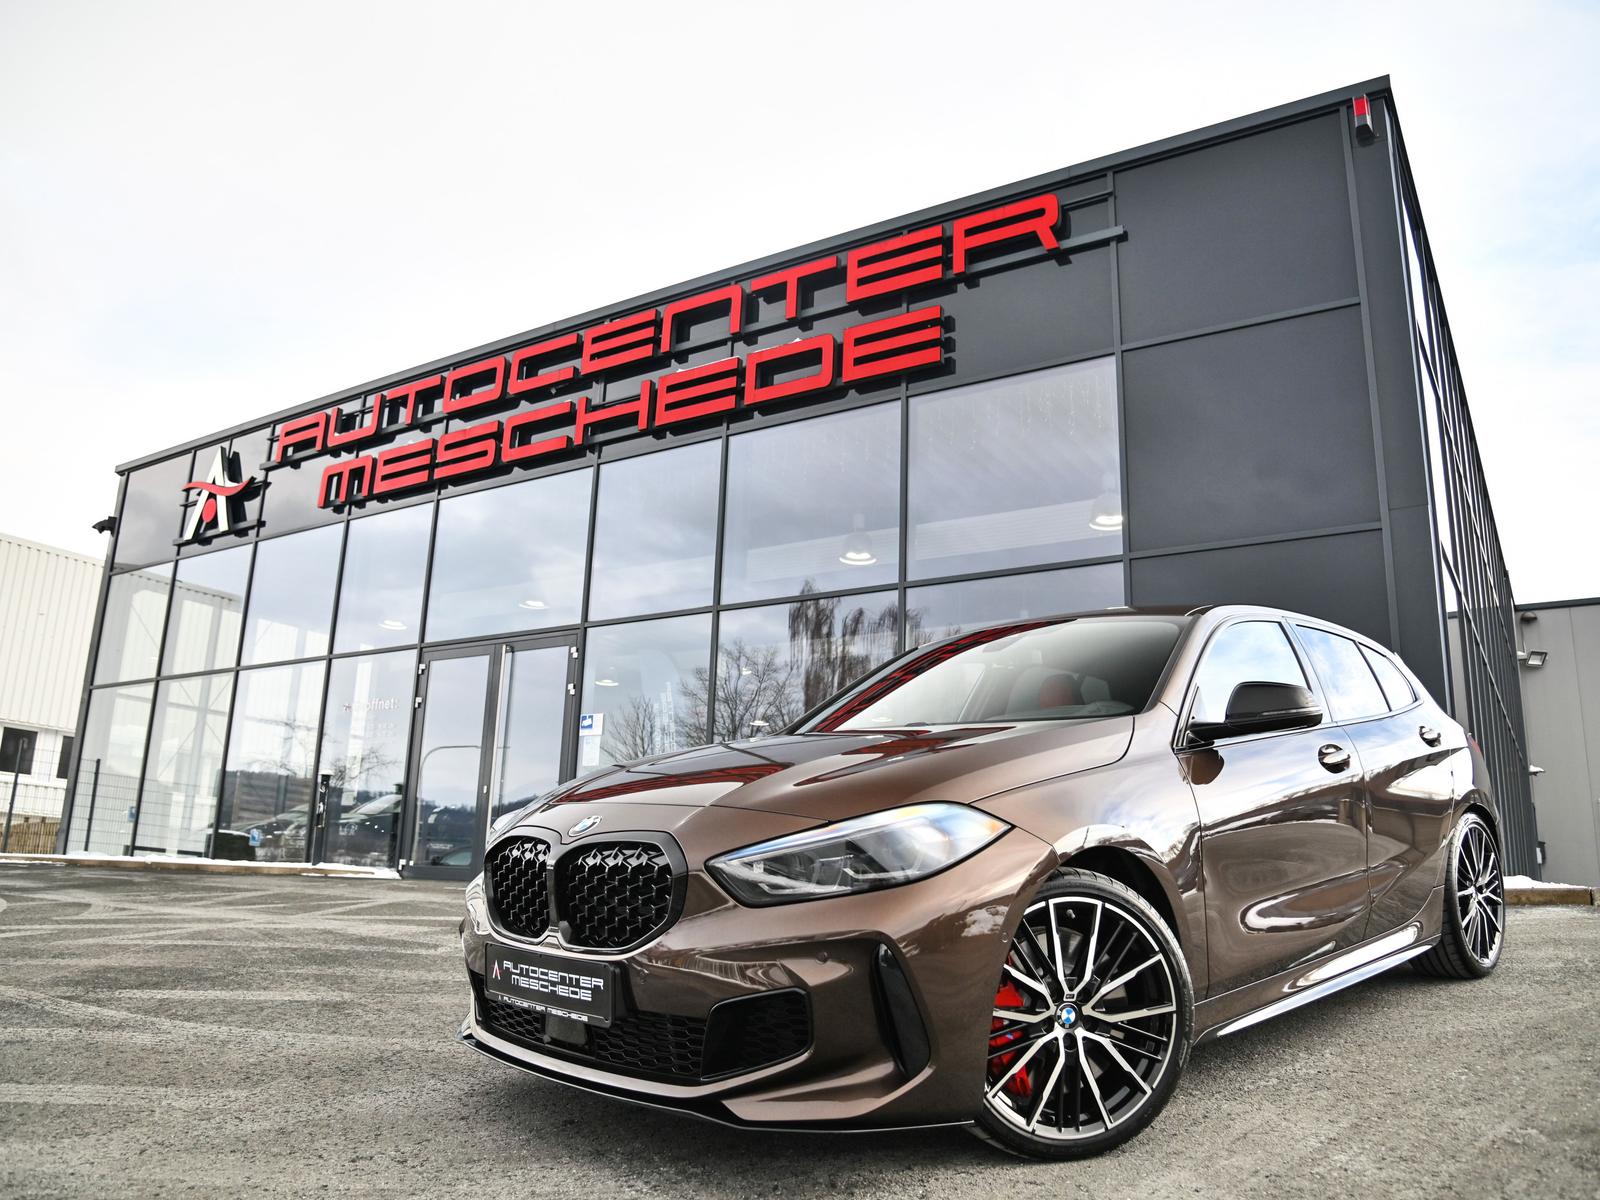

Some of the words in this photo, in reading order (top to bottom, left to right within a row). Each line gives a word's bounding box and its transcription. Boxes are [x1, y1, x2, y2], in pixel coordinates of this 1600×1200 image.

[274, 192, 1062, 463] AUTOCENTER
[317, 304, 944, 509] MESCHEDE
[503, 960, 604, 990] AUTOCENTER
[511, 975, 592, 1001] MESCHEDE
[503, 996, 546, 1012] AUTOCENTER
